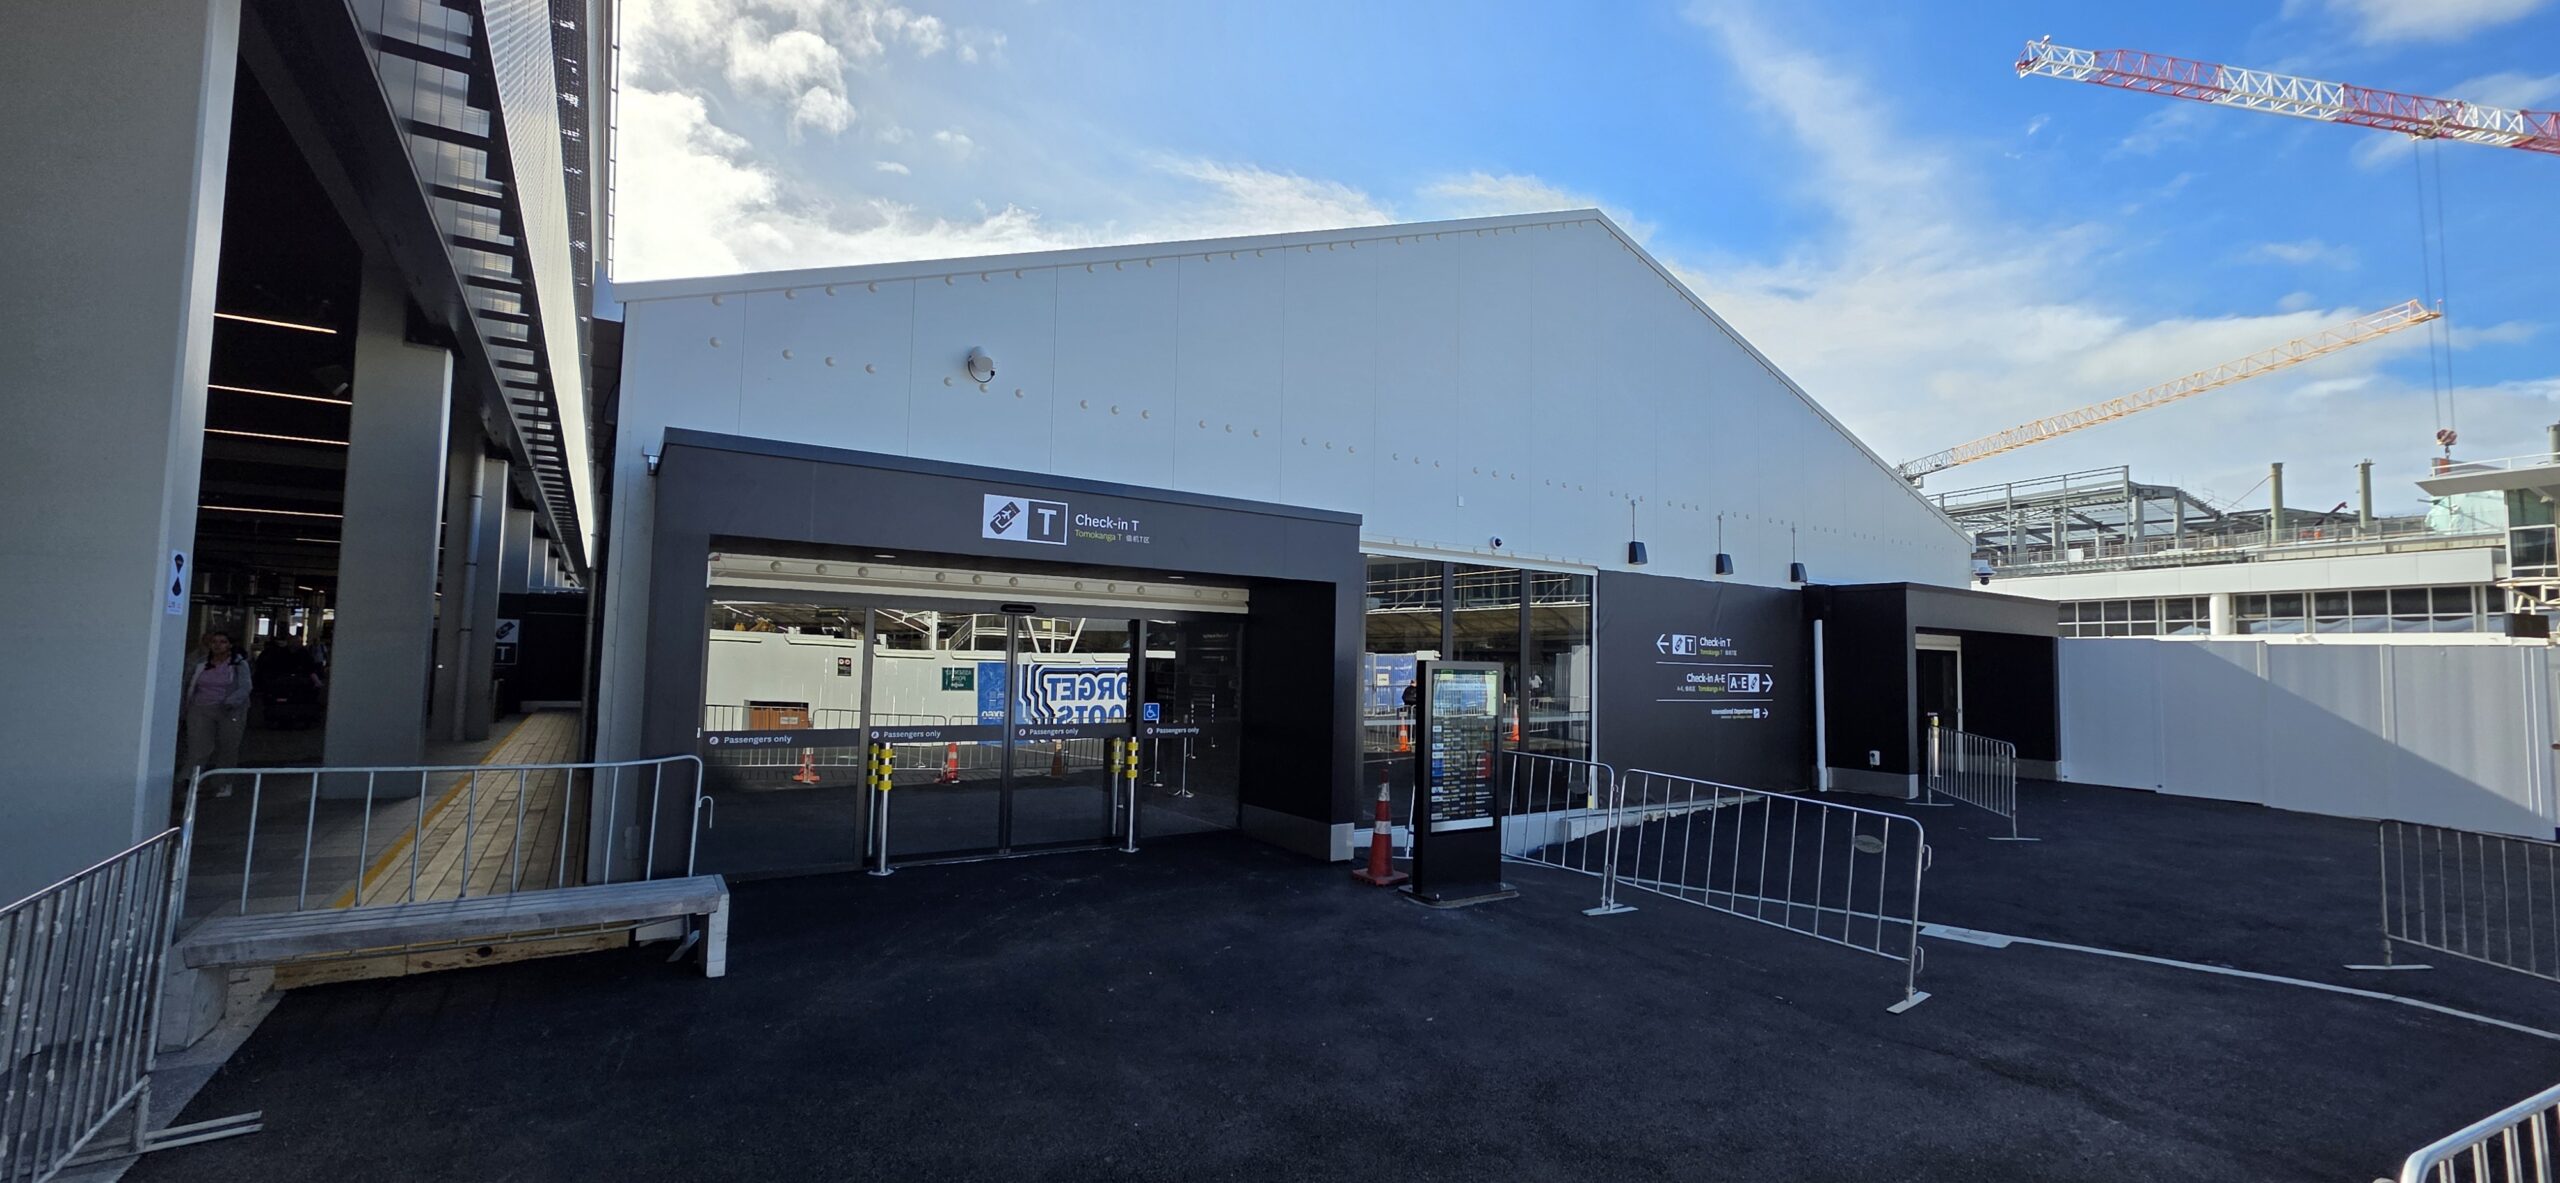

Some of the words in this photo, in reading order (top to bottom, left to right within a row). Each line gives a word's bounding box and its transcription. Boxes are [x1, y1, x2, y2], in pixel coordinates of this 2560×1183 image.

[1037, 508, 1057, 536] T
[1075, 513, 1128, 531] Check-in
[1131, 520, 1140, 532] T
[1074, 529, 1116, 542] Tomokanga
[1117, 533, 1123, 541] T
[1686, 639, 1694, 652] T
[1699, 636, 1726, 648] Check-in
[1726, 638, 1732, 648] T
[496, 646, 511, 661] T
[1686, 672, 1713, 683] Check-in
[1714, 674, 1726, 684] A-E
[1729, 676, 1748, 690] A-E
[883, 731, 924, 740] Passengers
[925, 730, 941, 739] only
[1029, 728, 1065, 737] Passengers
[1065, 727, 1080, 736] only
[1156, 727, 1187, 736] Passengers
[1187, 727, 1200, 736] only
[723, 736, 772, 745] Passengers
[773, 735, 792, 744] only
